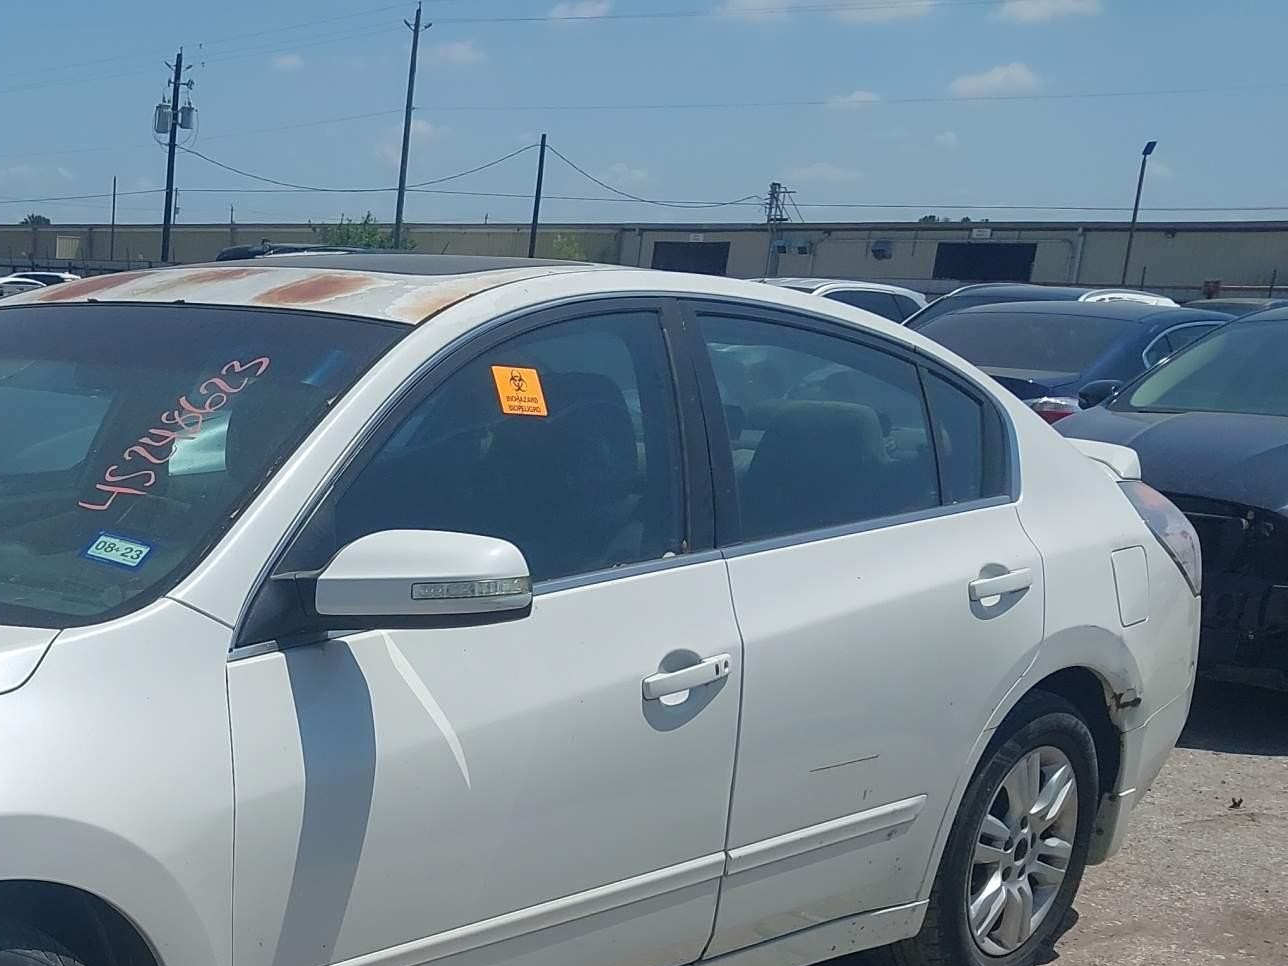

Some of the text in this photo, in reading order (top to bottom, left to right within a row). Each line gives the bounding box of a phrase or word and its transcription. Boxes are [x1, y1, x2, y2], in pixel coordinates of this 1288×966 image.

[78, 357, 270, 511] 45248623
[94, 540, 144, 560] 08 23
